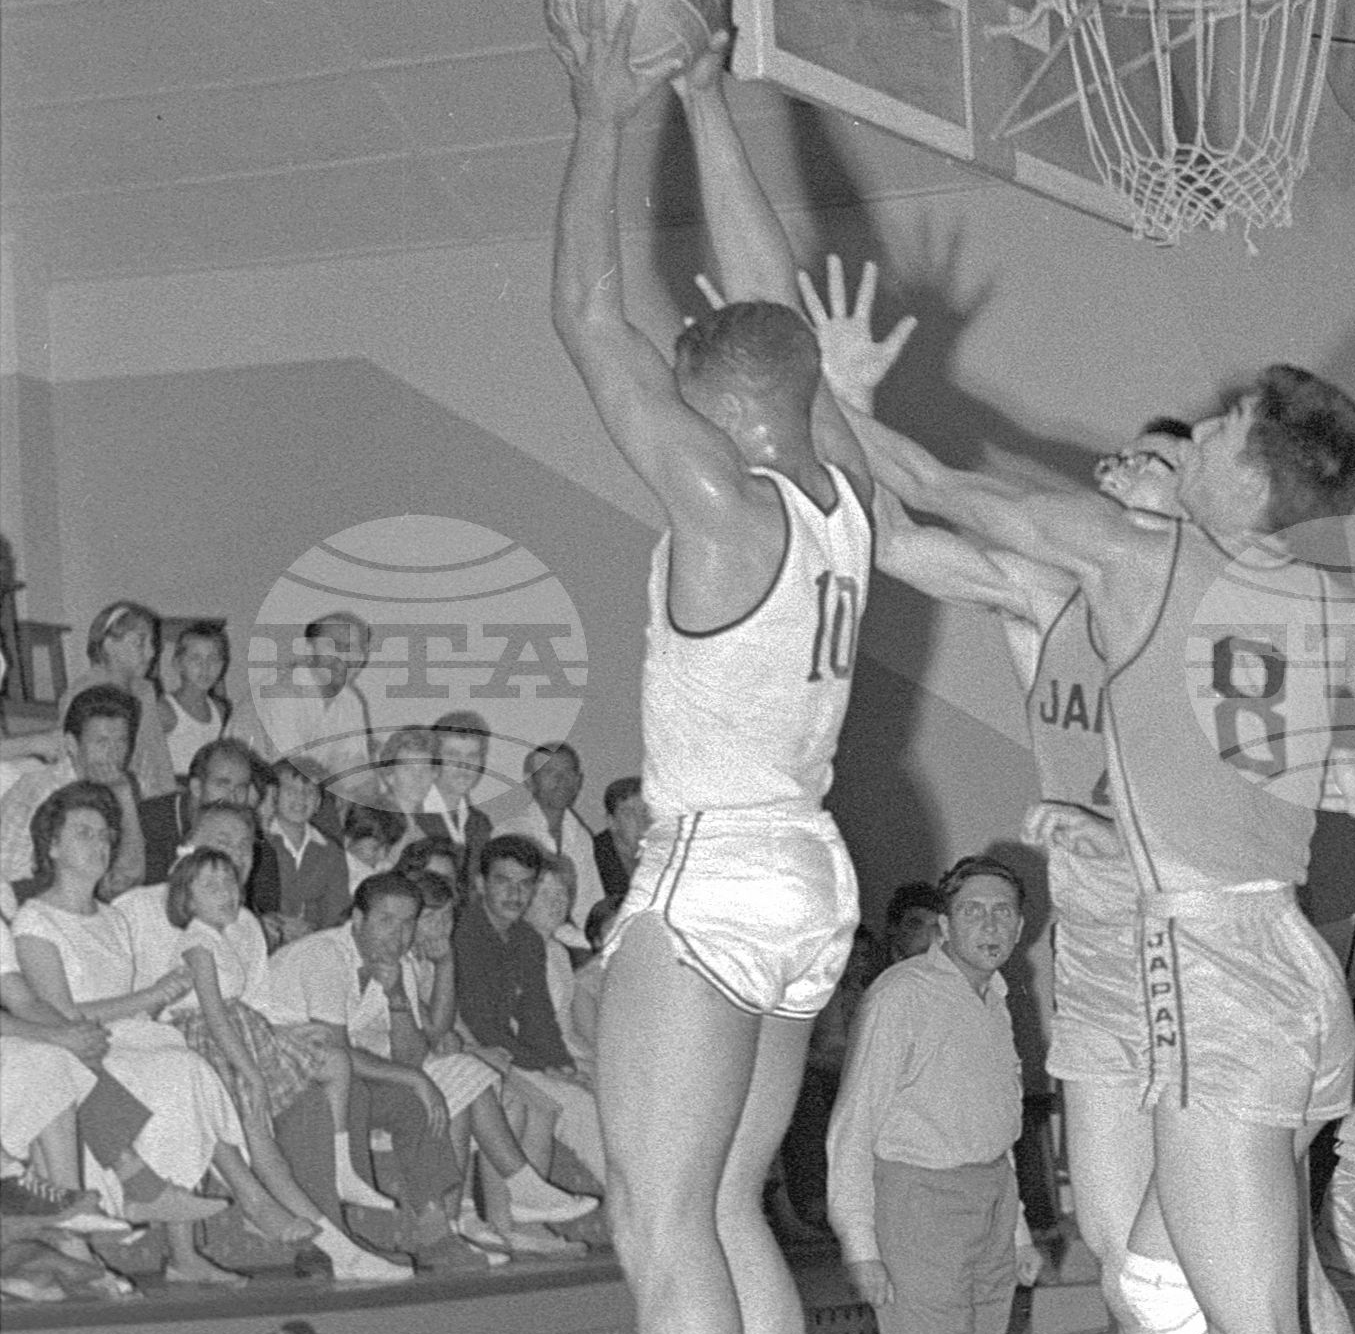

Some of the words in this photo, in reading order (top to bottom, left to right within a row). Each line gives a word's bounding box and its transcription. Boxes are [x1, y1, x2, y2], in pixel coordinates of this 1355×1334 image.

[807, 569, 858, 683] 10
[1211, 635, 1287, 777] 8
[1147, 932, 1177, 1048] JAPAN
